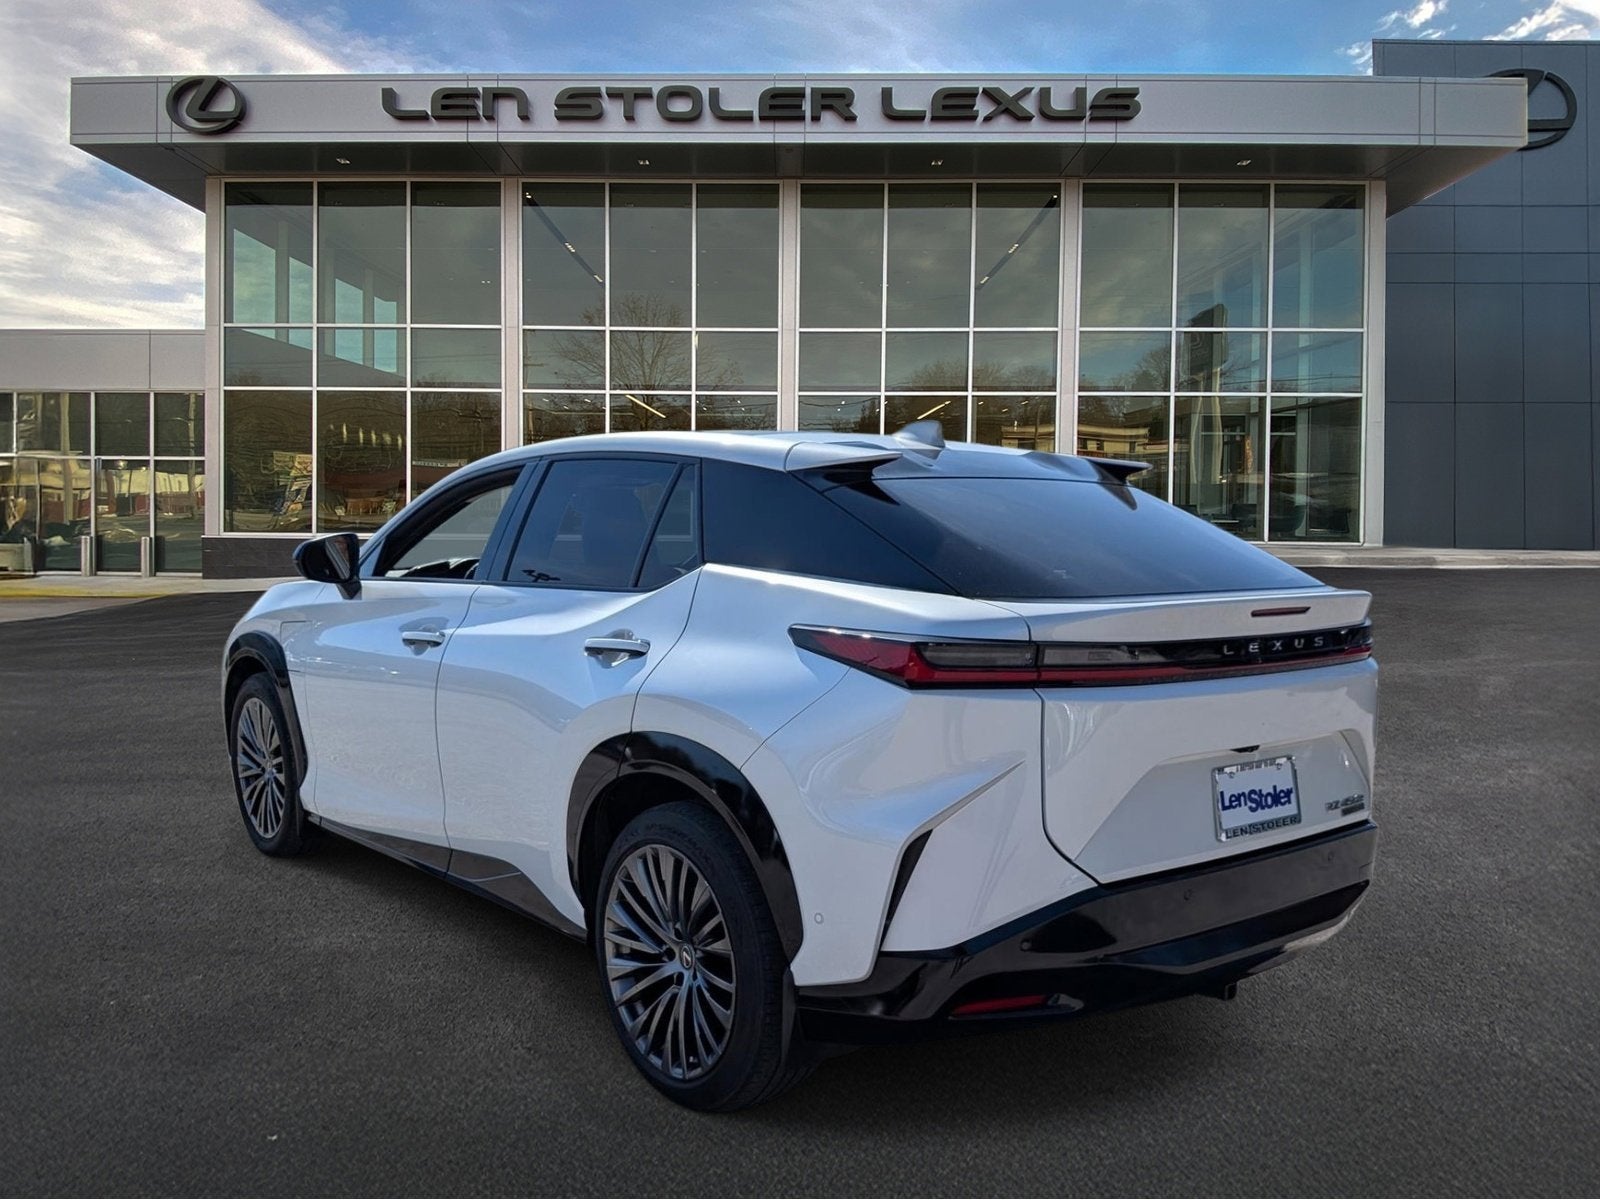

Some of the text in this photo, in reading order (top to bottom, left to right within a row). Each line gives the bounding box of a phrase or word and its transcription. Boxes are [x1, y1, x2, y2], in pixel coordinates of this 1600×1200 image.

[381, 87, 1142, 121] LEN STOLER LEXUS
[1223, 637, 1324, 655] LEXUS
[1225, 816, 1298, 839] LEN STOLER
